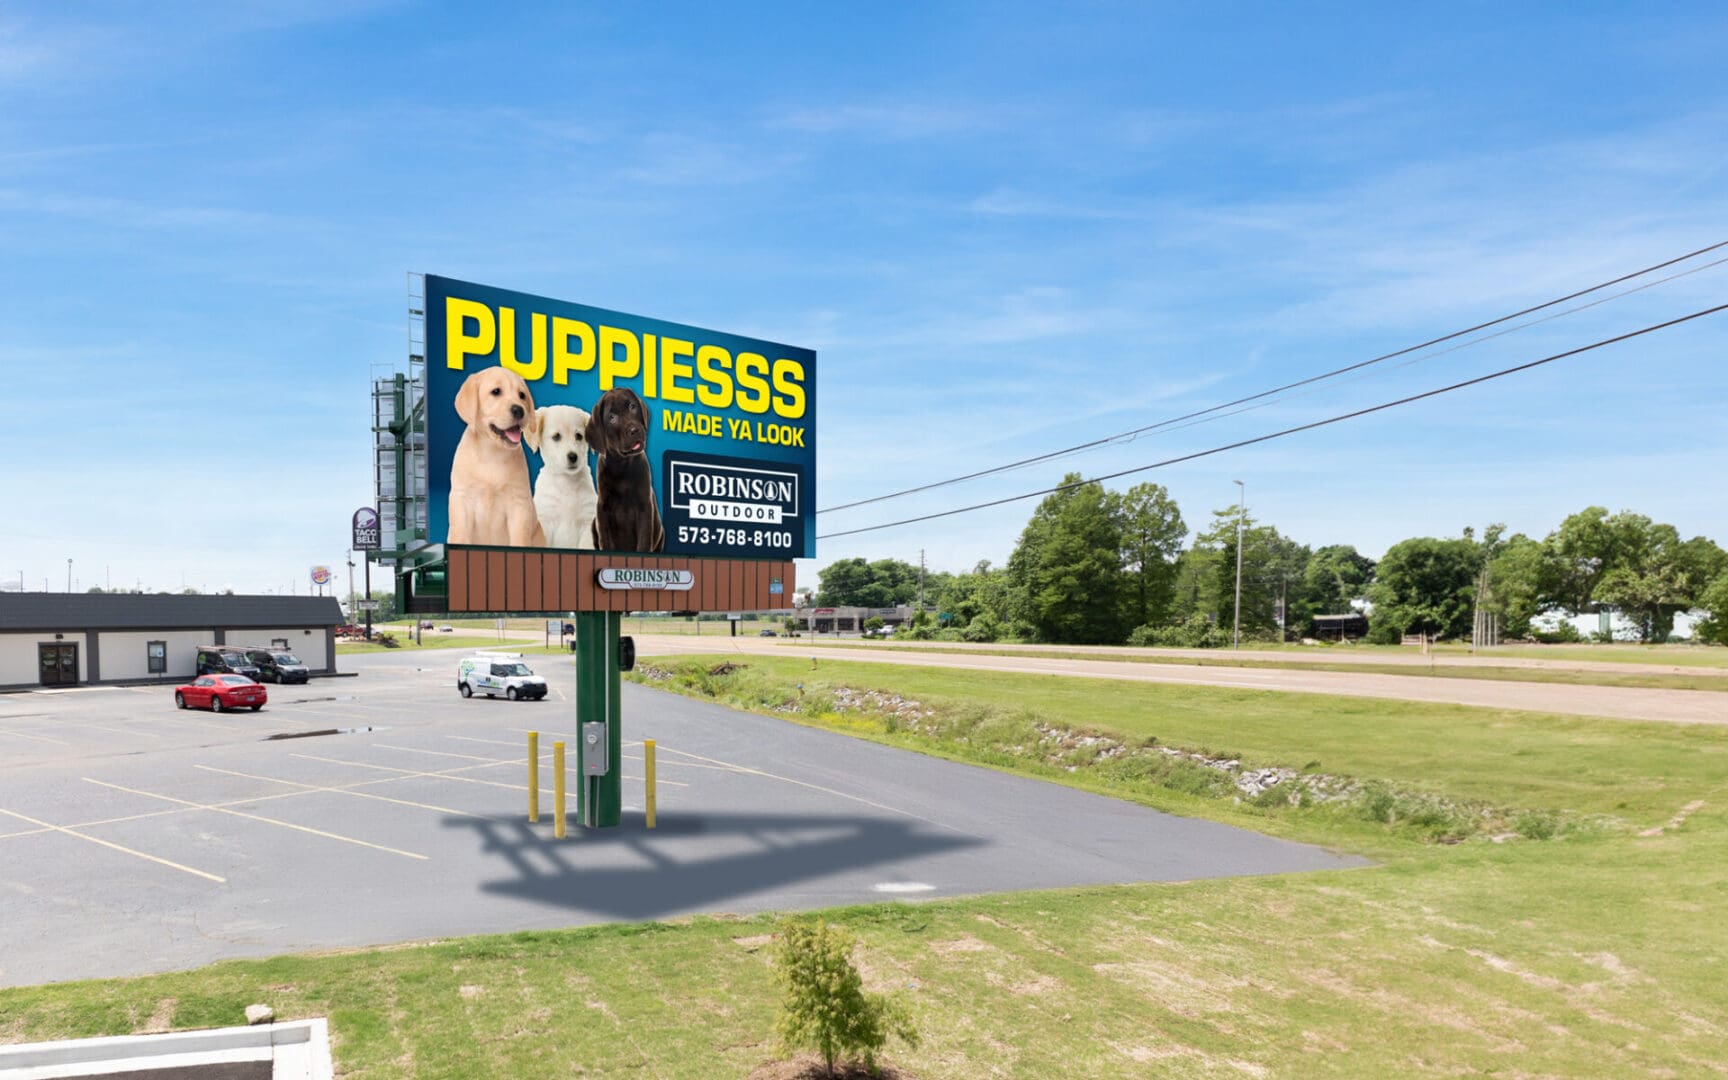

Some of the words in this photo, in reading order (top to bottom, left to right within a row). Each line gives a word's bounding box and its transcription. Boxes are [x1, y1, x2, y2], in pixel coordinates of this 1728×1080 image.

[446, 296, 806, 419] PUPPIESSS
[663, 409, 722, 438] MADE
[728, 418, 752, 441] YA
[757, 422, 805, 448] LOOK
[678, 472, 792, 502] ROBINSON
[697, 503, 775, 520] OUTDOOR
[355, 528, 376, 536] TACO
[356, 535, 376, 543] BELL
[678, 526, 792, 548] 573-768-8100
